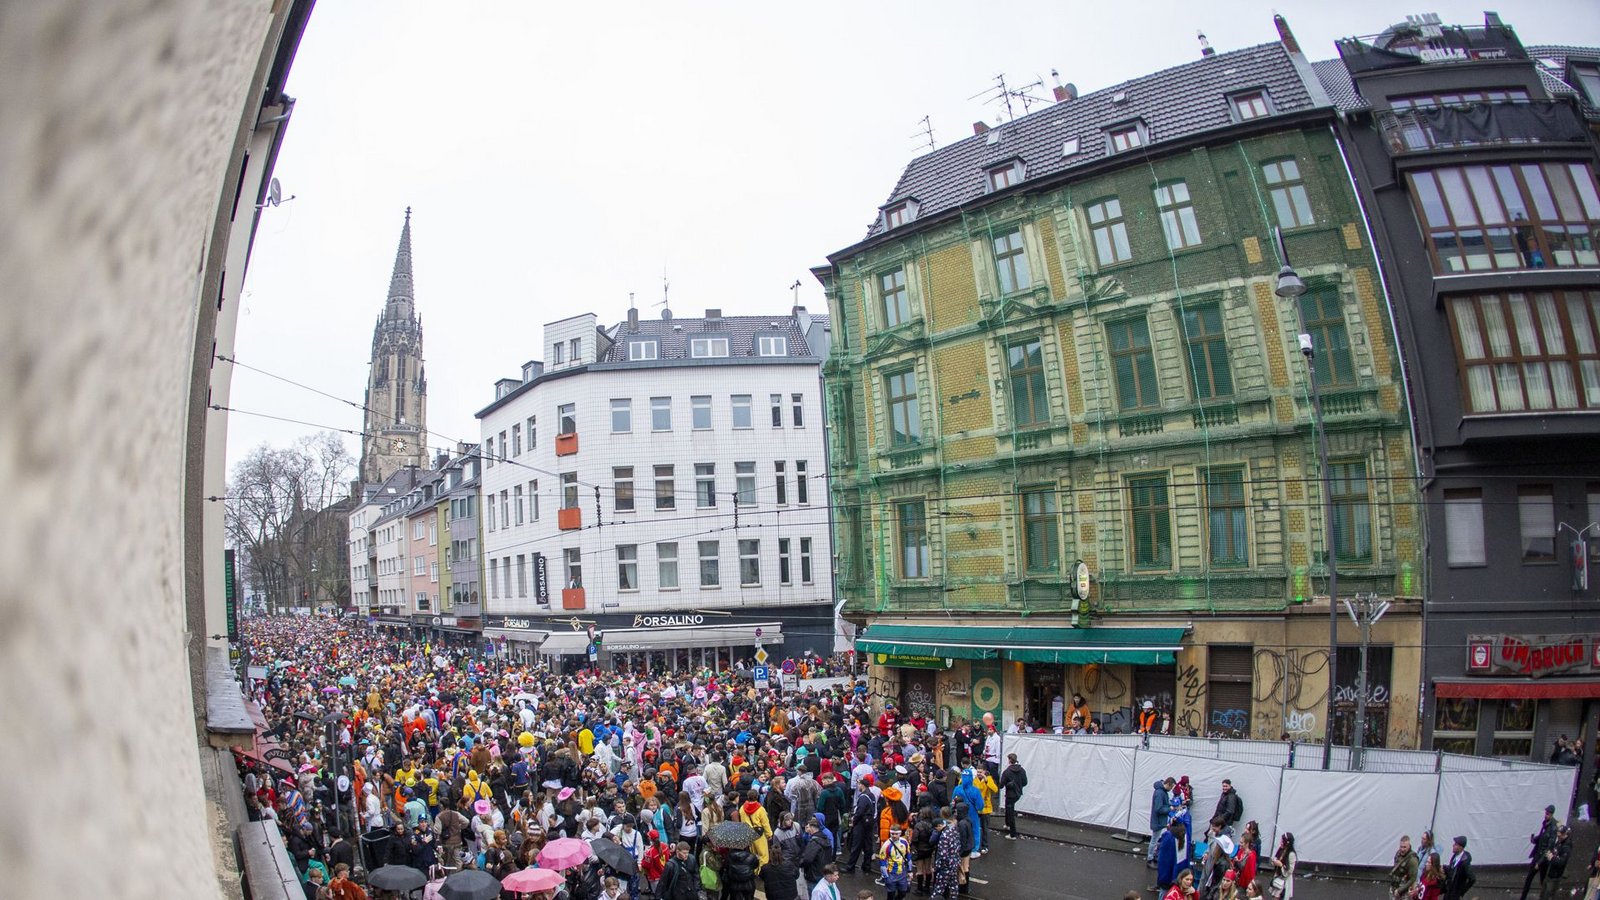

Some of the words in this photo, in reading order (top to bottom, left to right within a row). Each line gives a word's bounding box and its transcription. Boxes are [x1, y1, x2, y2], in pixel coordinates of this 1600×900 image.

[538, 557, 547, 603] BORSALINO
[503, 616, 530, 629] BORSALINO
[632, 614, 704, 628] BORSALINO
[1502, 636, 1584, 673] UMBRUCH
[756, 668, 764, 679] P
